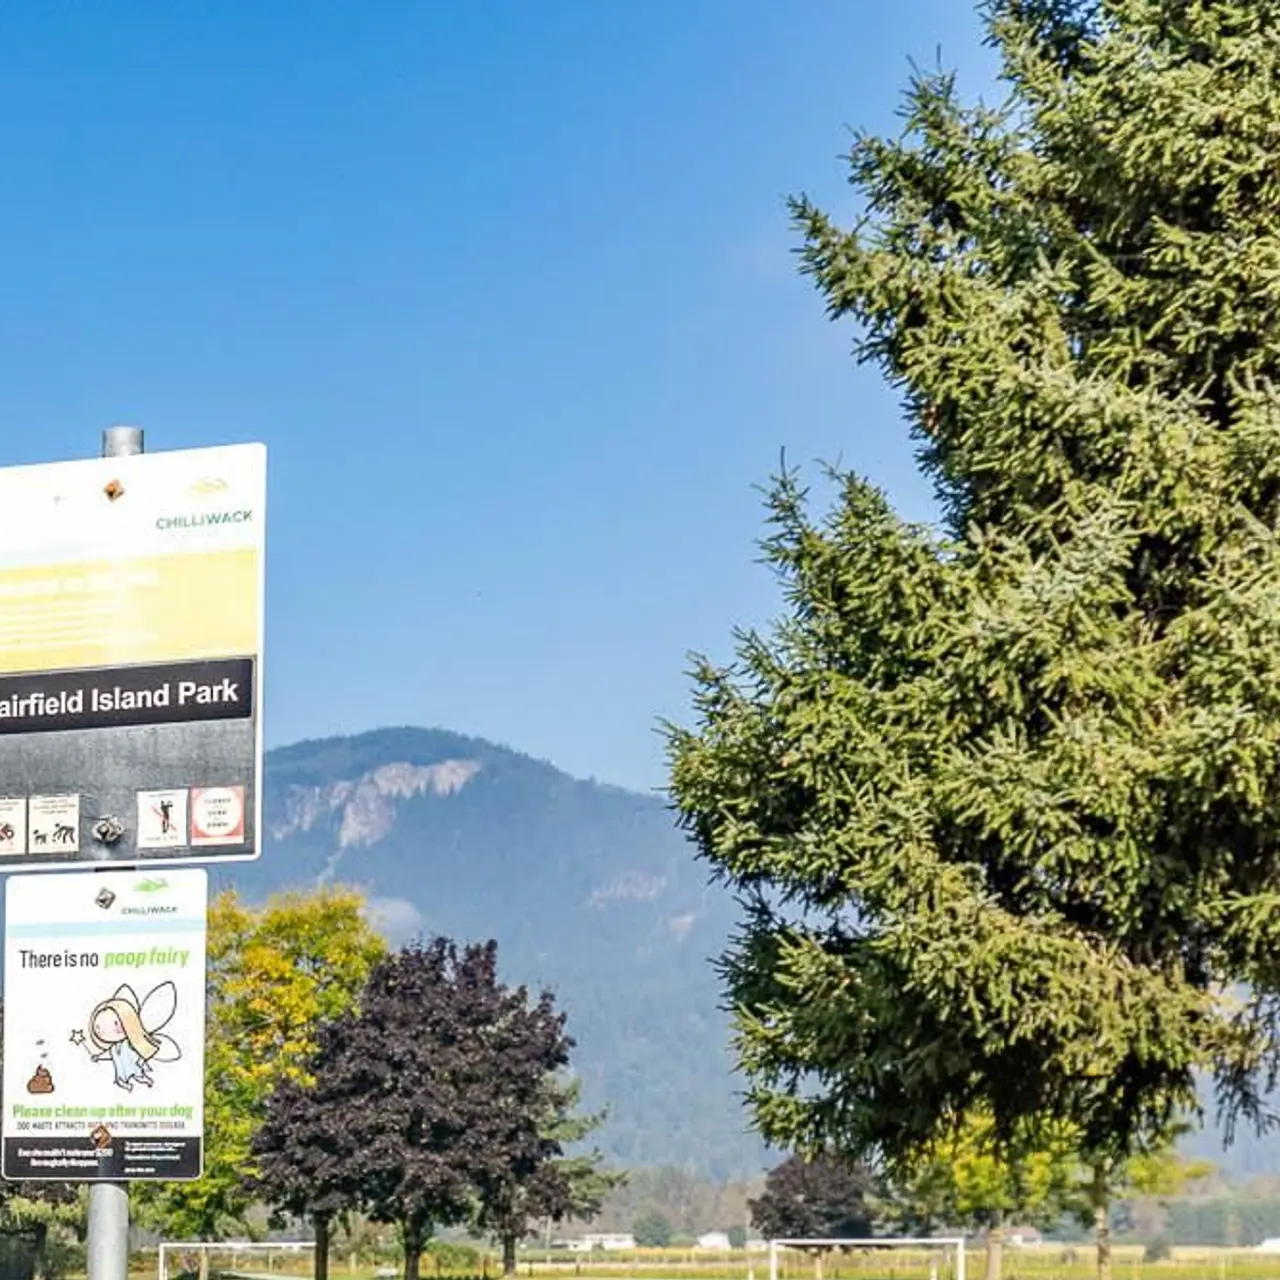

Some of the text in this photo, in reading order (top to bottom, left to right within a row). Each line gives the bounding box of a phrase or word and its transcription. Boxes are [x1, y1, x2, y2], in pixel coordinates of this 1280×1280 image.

[156, 510, 253, 530] CHILLIWACK
[90, 684, 170, 712] Island
[177, 678, 239, 705] Park
[19, 946, 191, 969] There is no poop fairy
[13, 1103, 194, 1120] Please clean up after your dog
